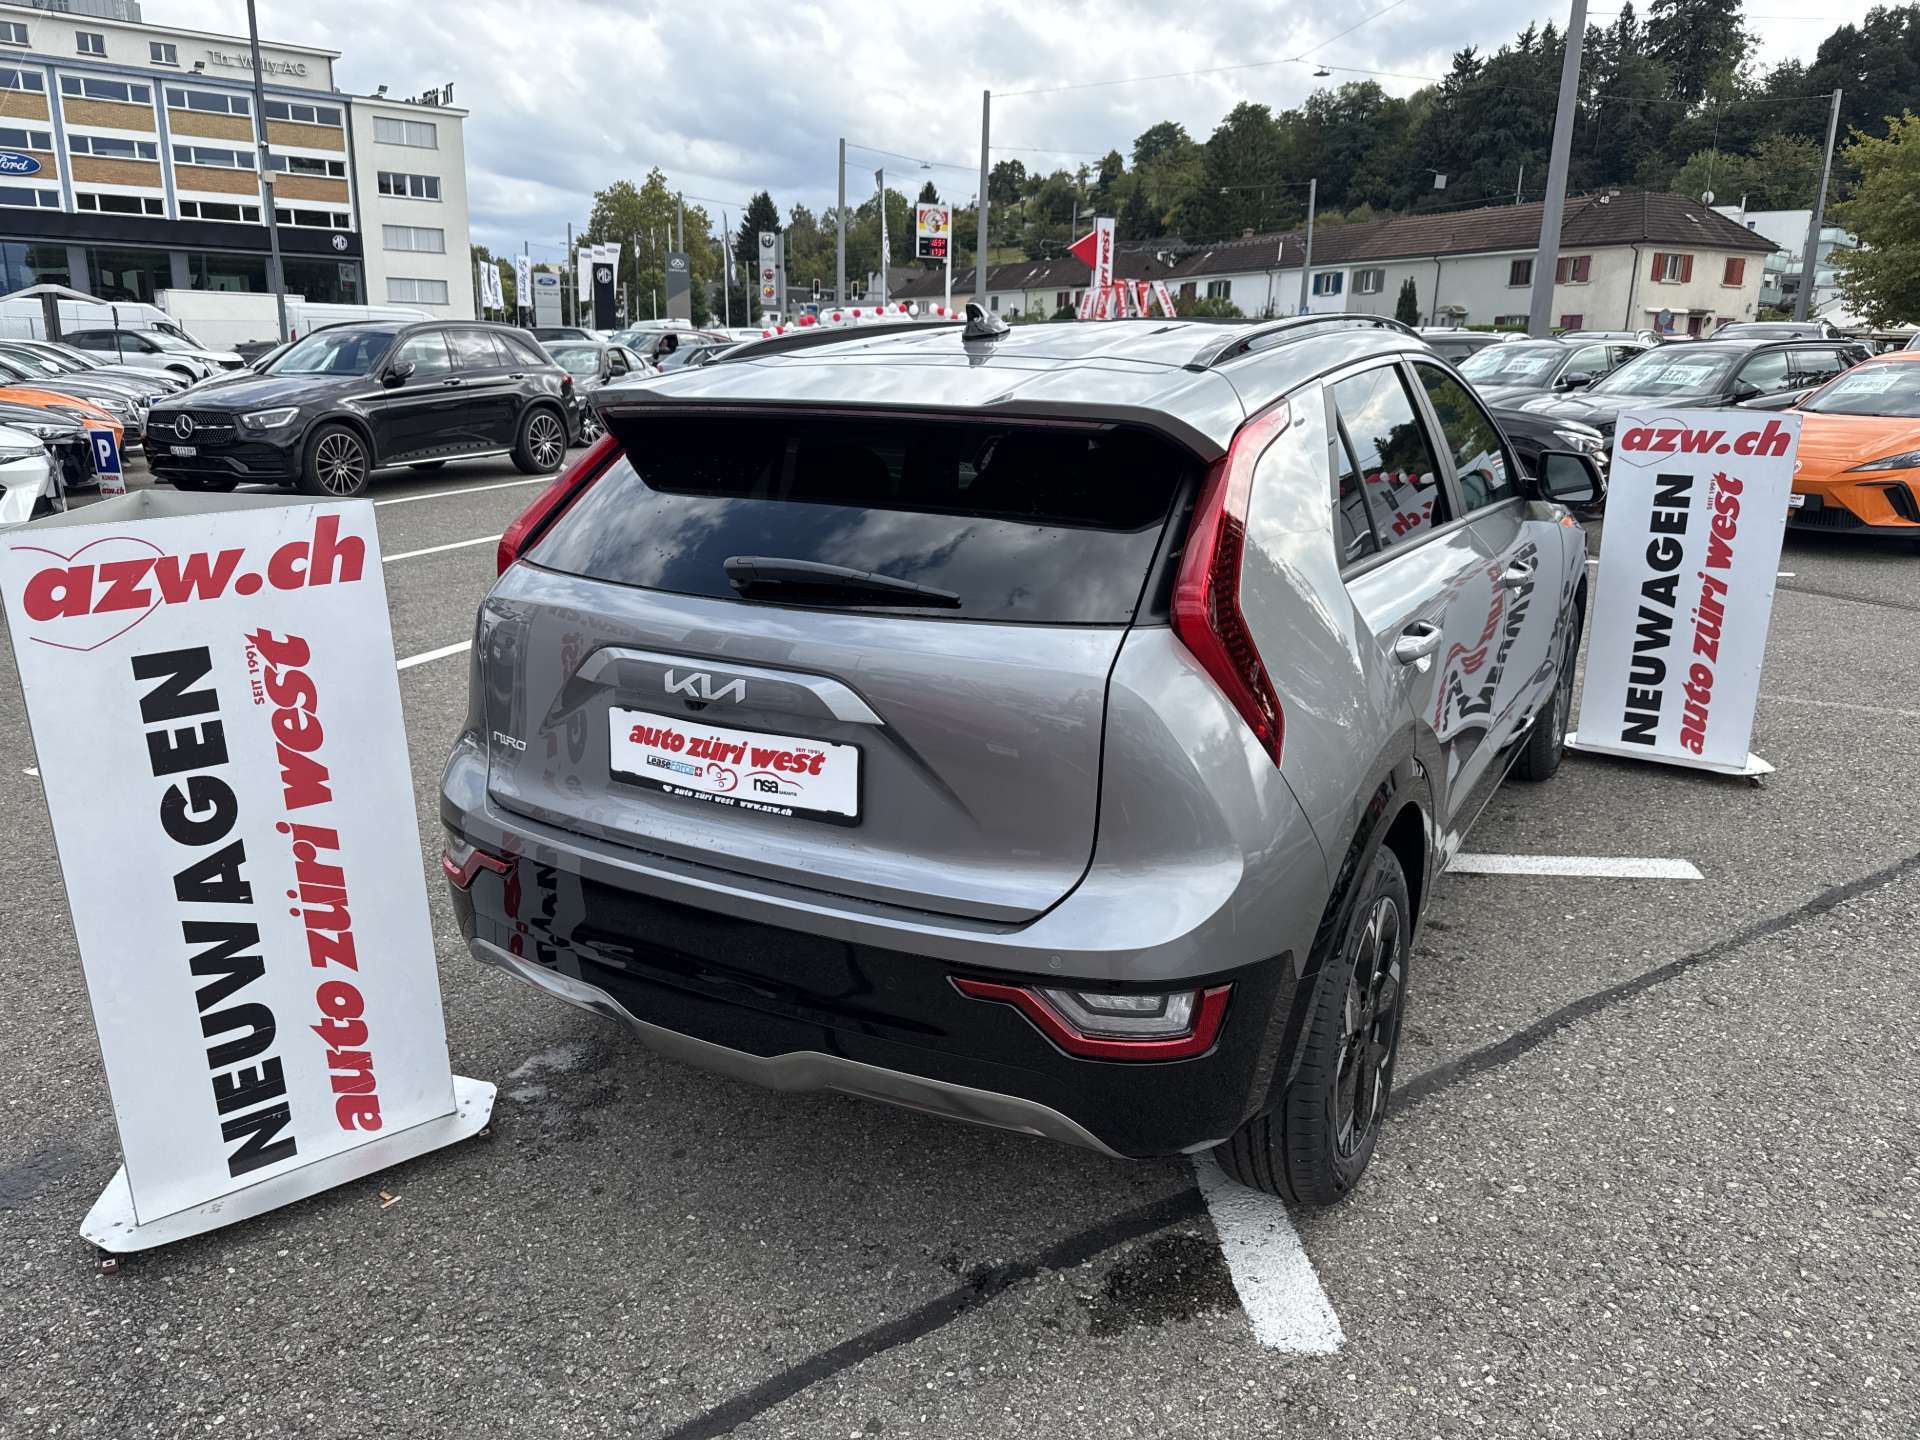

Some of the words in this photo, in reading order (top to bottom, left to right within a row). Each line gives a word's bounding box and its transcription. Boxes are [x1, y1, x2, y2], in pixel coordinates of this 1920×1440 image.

[283, 60, 308, 76] AG
[97, 439, 112, 467] P
[1622, 420, 1791, 457] azw.ch
[1706, 471, 1743, 569] west
[24, 515, 366, 621] azw.ch
[1621, 473, 1694, 746] NEUWAGEN
[1691, 571, 1728, 662] züri
[245, 644, 259, 675] 1991
[251, 679, 265, 705] SEIT
[244, 627, 333, 811] west
[493, 731, 527, 751] NIRO
[1680, 663, 1713, 754] auto
[629, 724, 685, 753] auto
[687, 736, 748, 765] züri
[751, 747, 826, 776] west
[753, 777, 779, 794] nsa
[674, 787, 694, 798] auto
[694, 790, 713, 802] züri
[714, 794, 735, 806] west
[739, 799, 793, 816] www.azw.ch
[131, 646, 298, 1178] NEUWAGEN
[275, 821, 359, 971] züri
[309, 980, 382, 1131] auto
